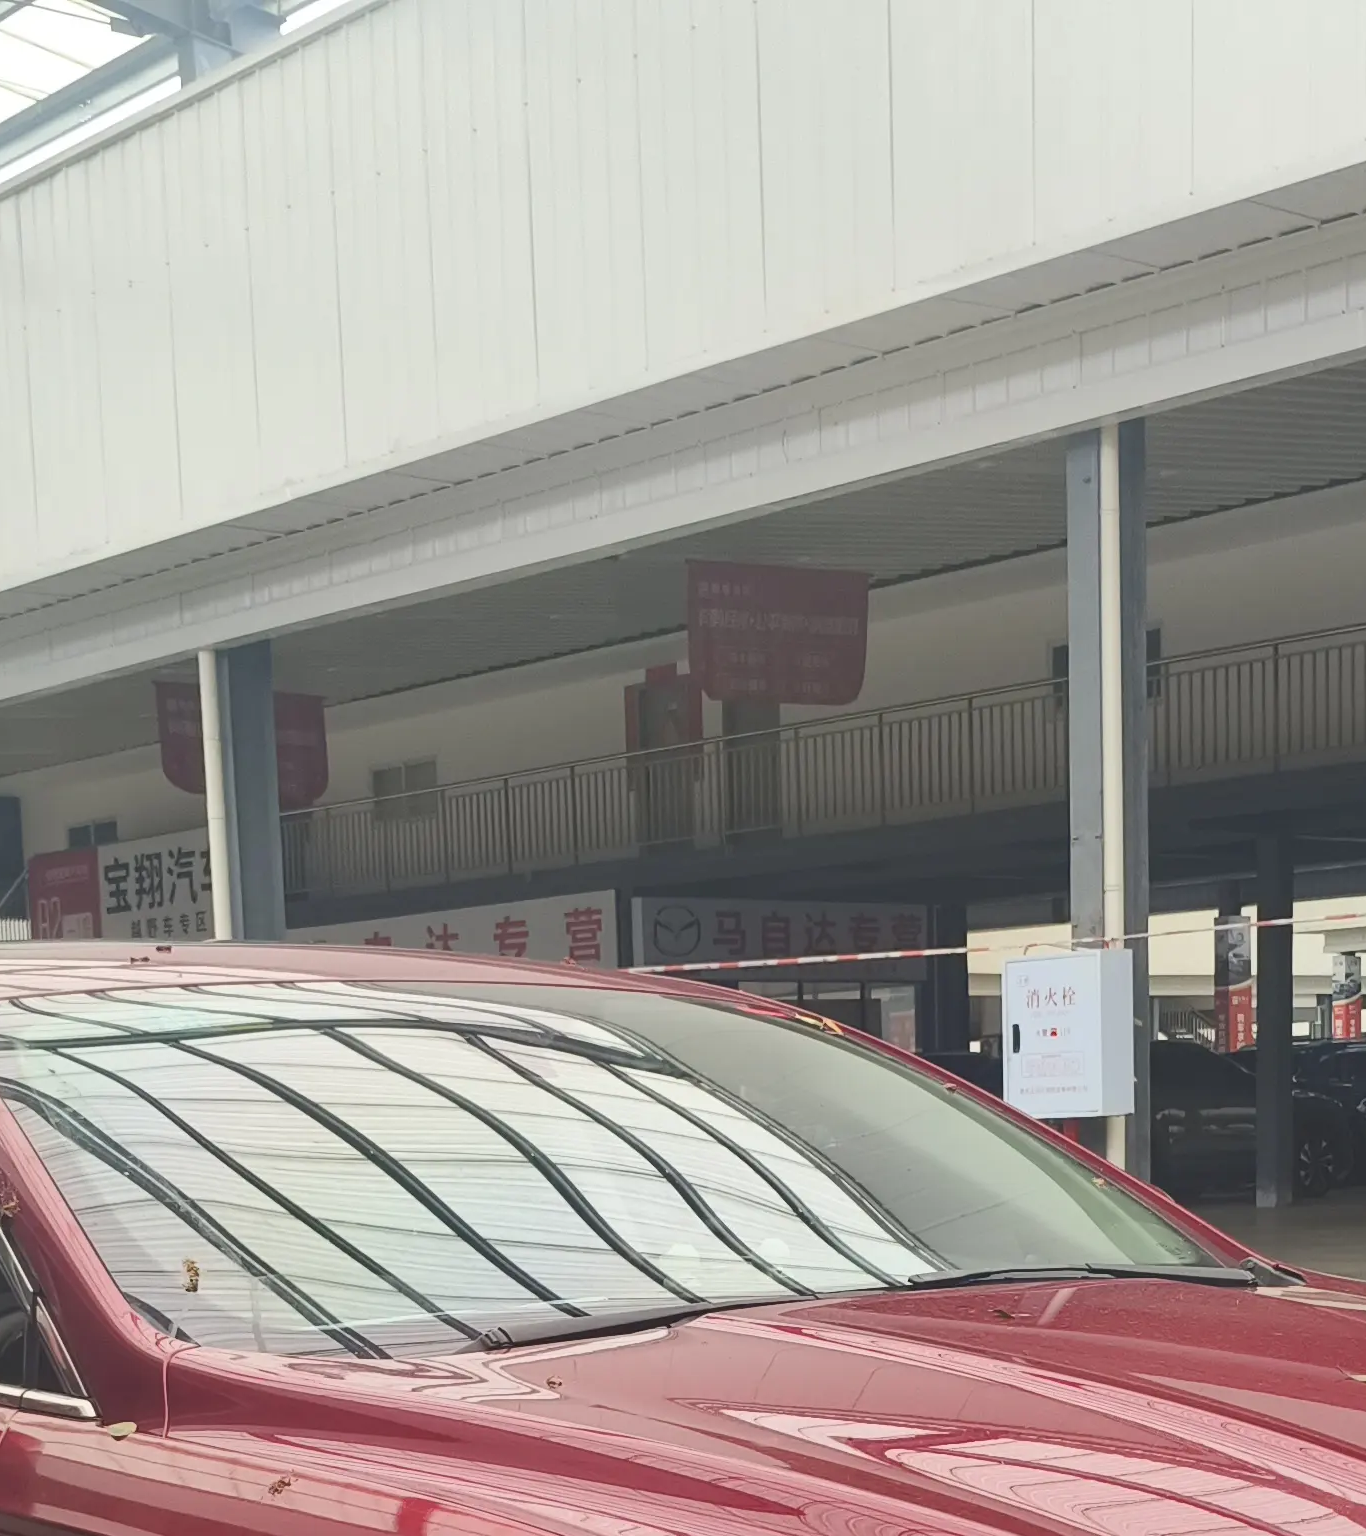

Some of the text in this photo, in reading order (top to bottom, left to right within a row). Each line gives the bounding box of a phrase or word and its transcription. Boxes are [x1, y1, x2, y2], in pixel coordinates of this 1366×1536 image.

[713, 910, 922, 956] 马自达专营
[1026, 986, 1076, 1009] 消火栓
